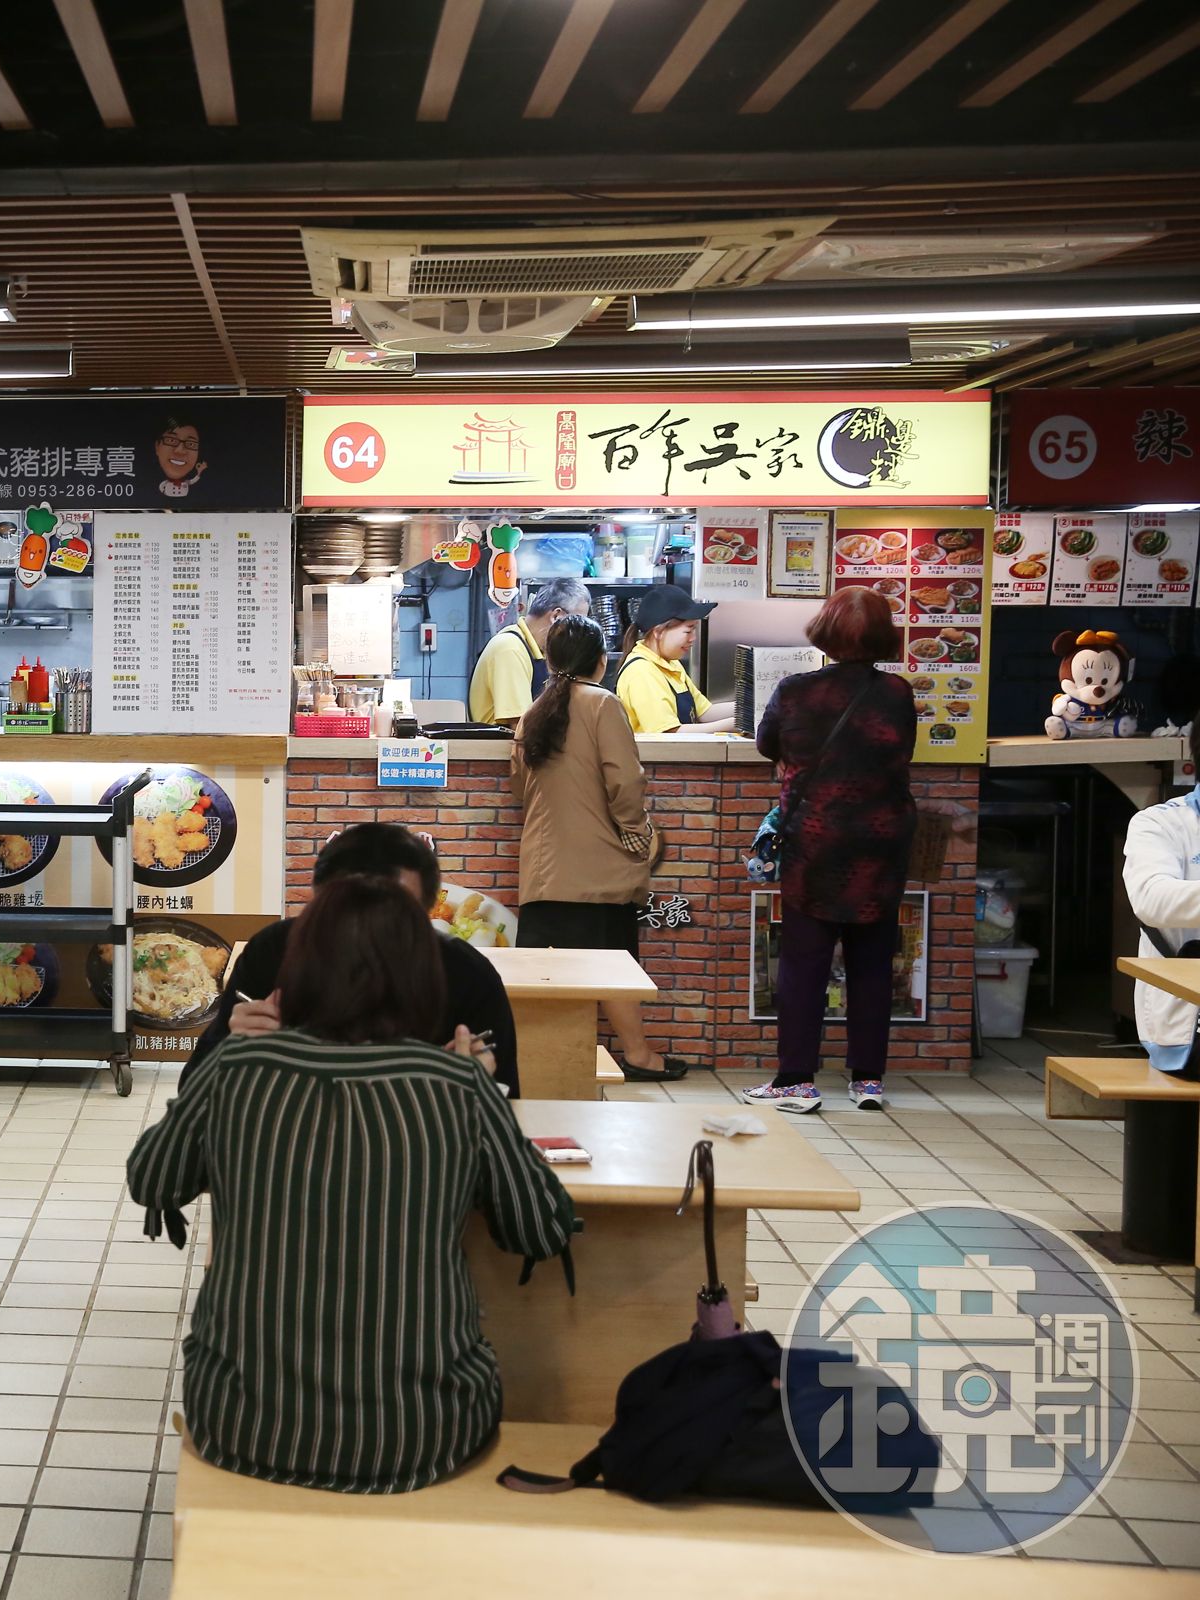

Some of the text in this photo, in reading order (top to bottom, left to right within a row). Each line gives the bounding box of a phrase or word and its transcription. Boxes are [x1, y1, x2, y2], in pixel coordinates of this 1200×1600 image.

[1038, 430, 1088, 464] 65
[1132, 408, 1193, 465] 辣
[331, 436, 378, 469] 64
[556, 411, 576, 490] 基隆廟口
[588, 409, 803, 496] 百年吳家
[17, 484, 135, 498] 0953-286-000
[733, 580, 749, 588] 140
[382, 747, 419, 757] 歡迎使用
[381, 768, 443, 778] 悠遊卡精選商家
[136, 895, 194, 911] 腰內牡蠣
